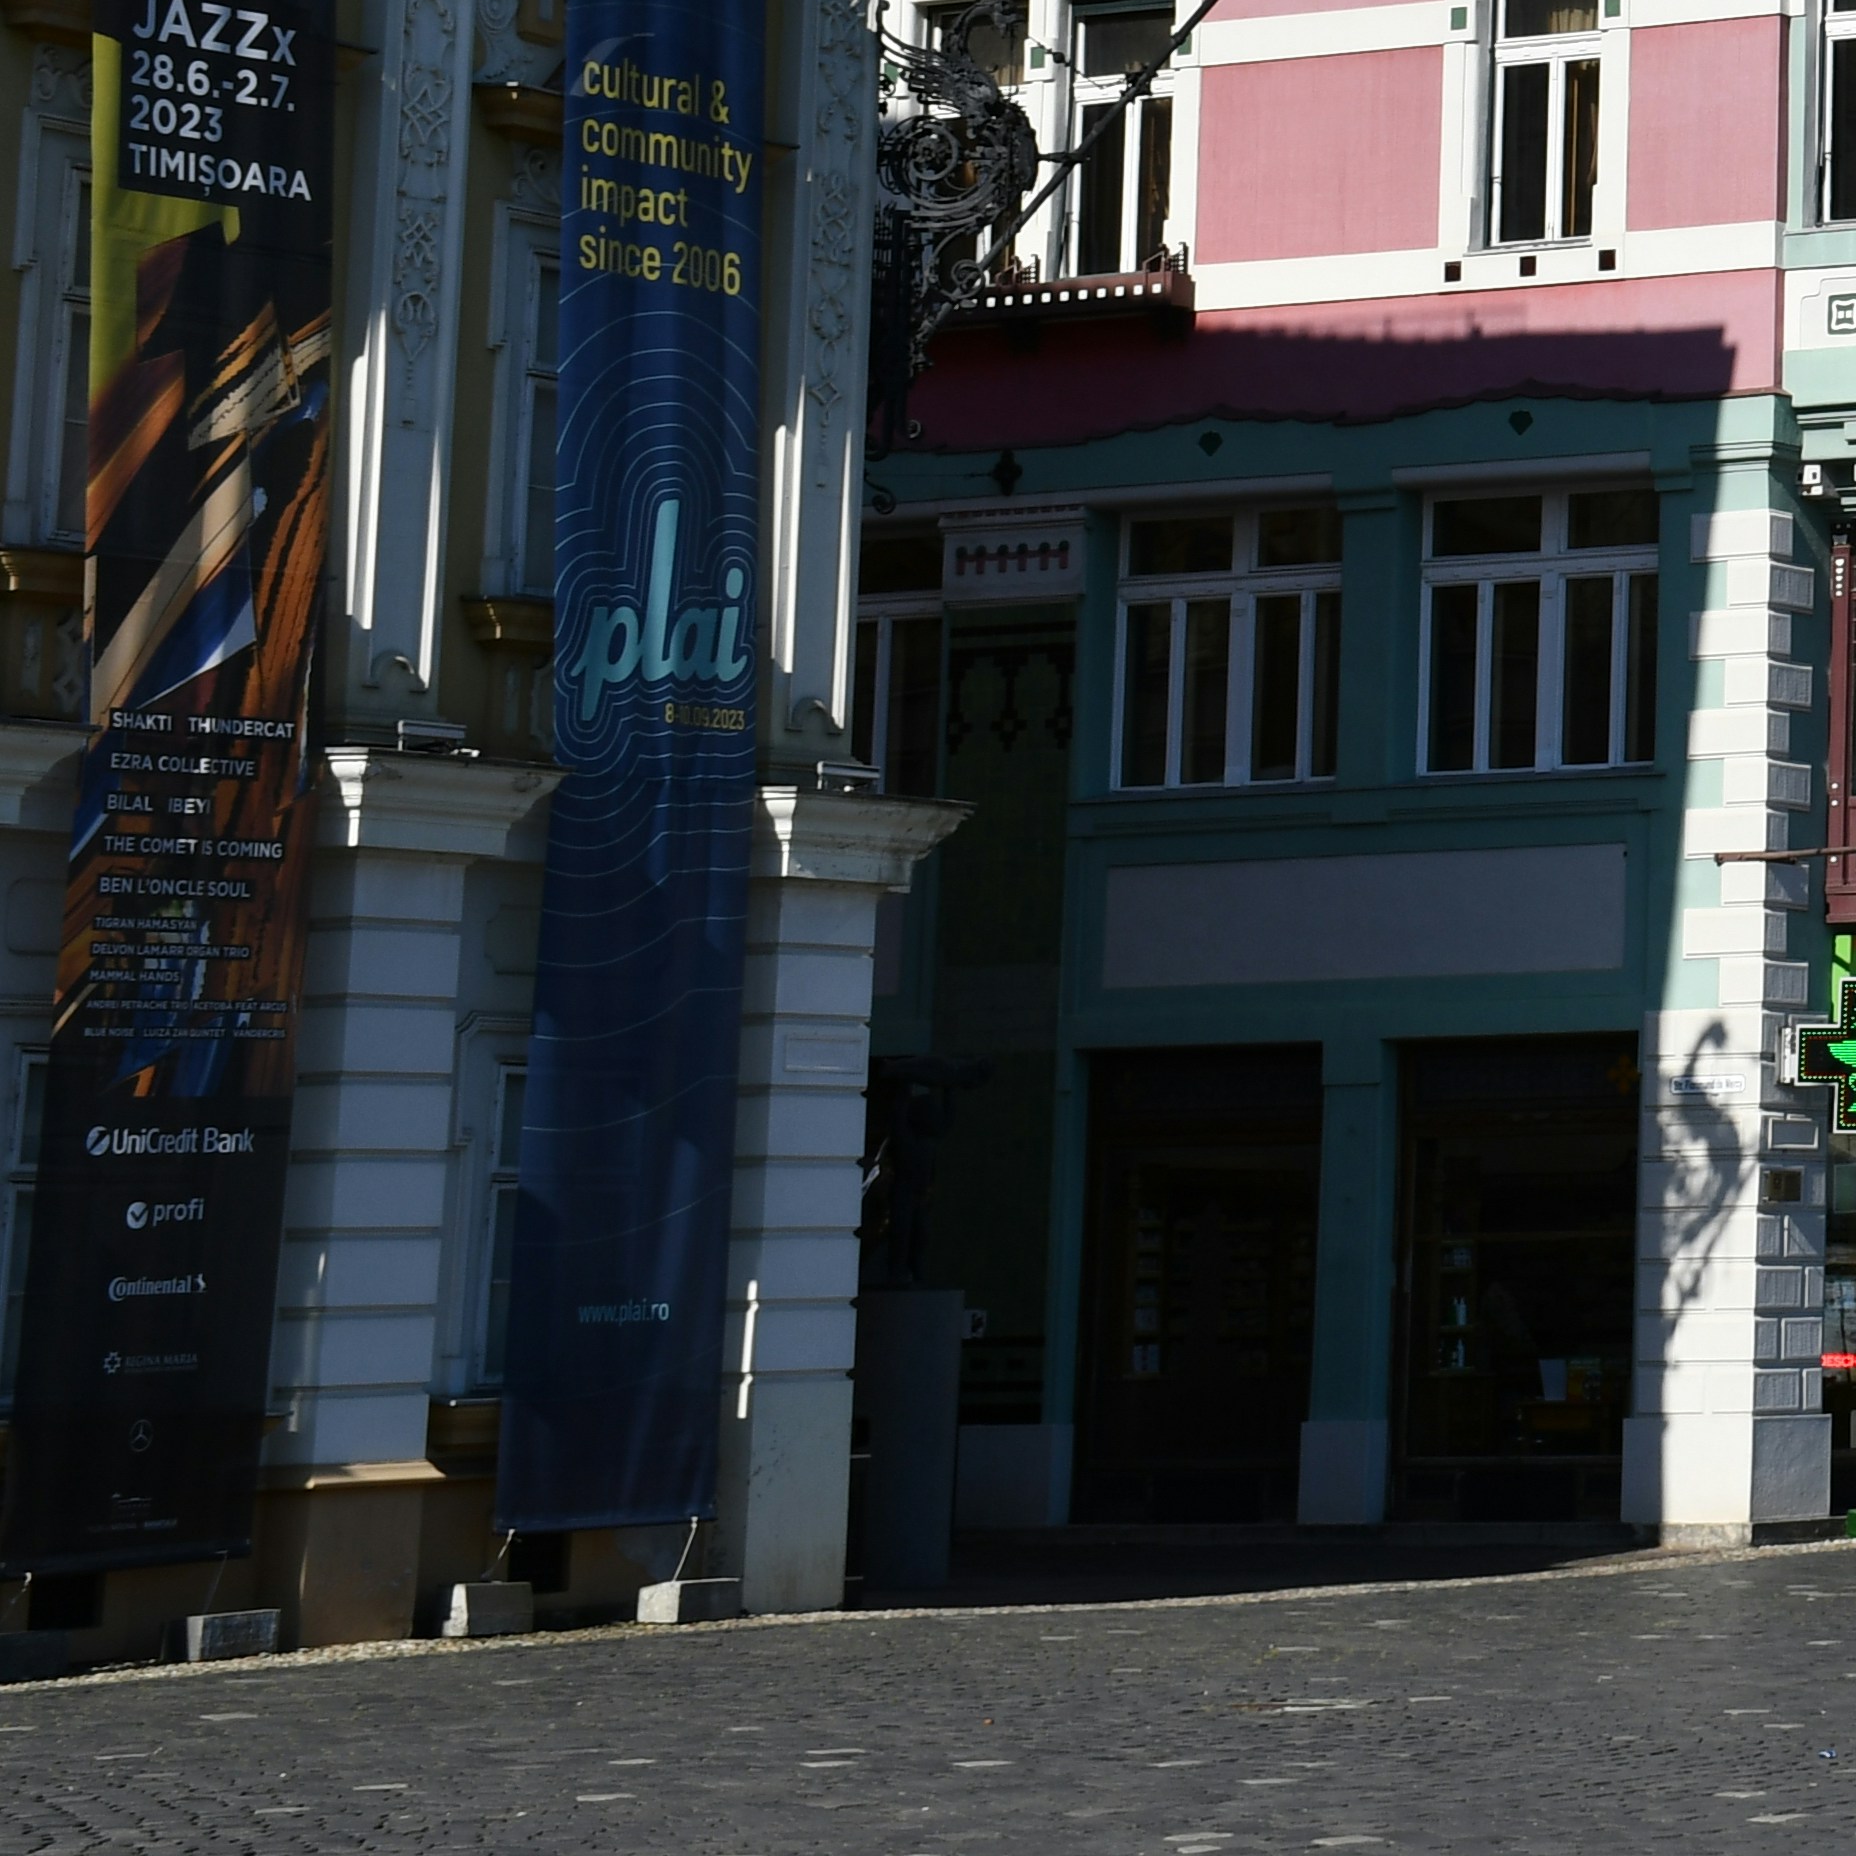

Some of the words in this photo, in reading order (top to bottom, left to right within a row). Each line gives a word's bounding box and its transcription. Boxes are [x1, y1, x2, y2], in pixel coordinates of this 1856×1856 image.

[582, 58, 700, 116] cultural
[709, 79, 730, 125] &
[130, 95, 223, 143] 2023
[582, 118, 753, 194] community
[128, 142, 312, 202] TIMIȘOARA
[581, 166, 689, 228] impact
[579, 227, 662, 282] since
[672, 241, 741, 296] 2006
[570, 499, 748, 721] plai
[112, 711, 173, 733] SHAKTI
[188, 717, 295, 739] THUNDERCAT
[111, 753, 153, 772] EZRA
[158, 755, 256, 776] COLLECTIVE
[107, 794, 153, 812] BILAL
[168, 797, 211, 815] IBEYI
[104, 835, 135, 854] THE
[140, 838, 198, 855] COMET
[202, 840, 213, 856] IS
[217, 840, 284, 859] COMING
[100, 877, 133, 894] BEN
[207, 881, 251, 898] SOUL
[95, 917, 136, 930] TIGRAN
[137, 917, 198, 931] HAMASYAN
[92, 943, 135, 956] DELVON
[222, 947, 250, 958] TRIO
[89, 969, 136, 982] MAMMAL
[140, 971, 180, 983] HANDS
[112, 1128, 199, 1155] UniCredit
[203, 1127, 255, 1154] Bank
[152, 1198, 205, 1227] profi
[108, 1275, 192, 1301] Continental
